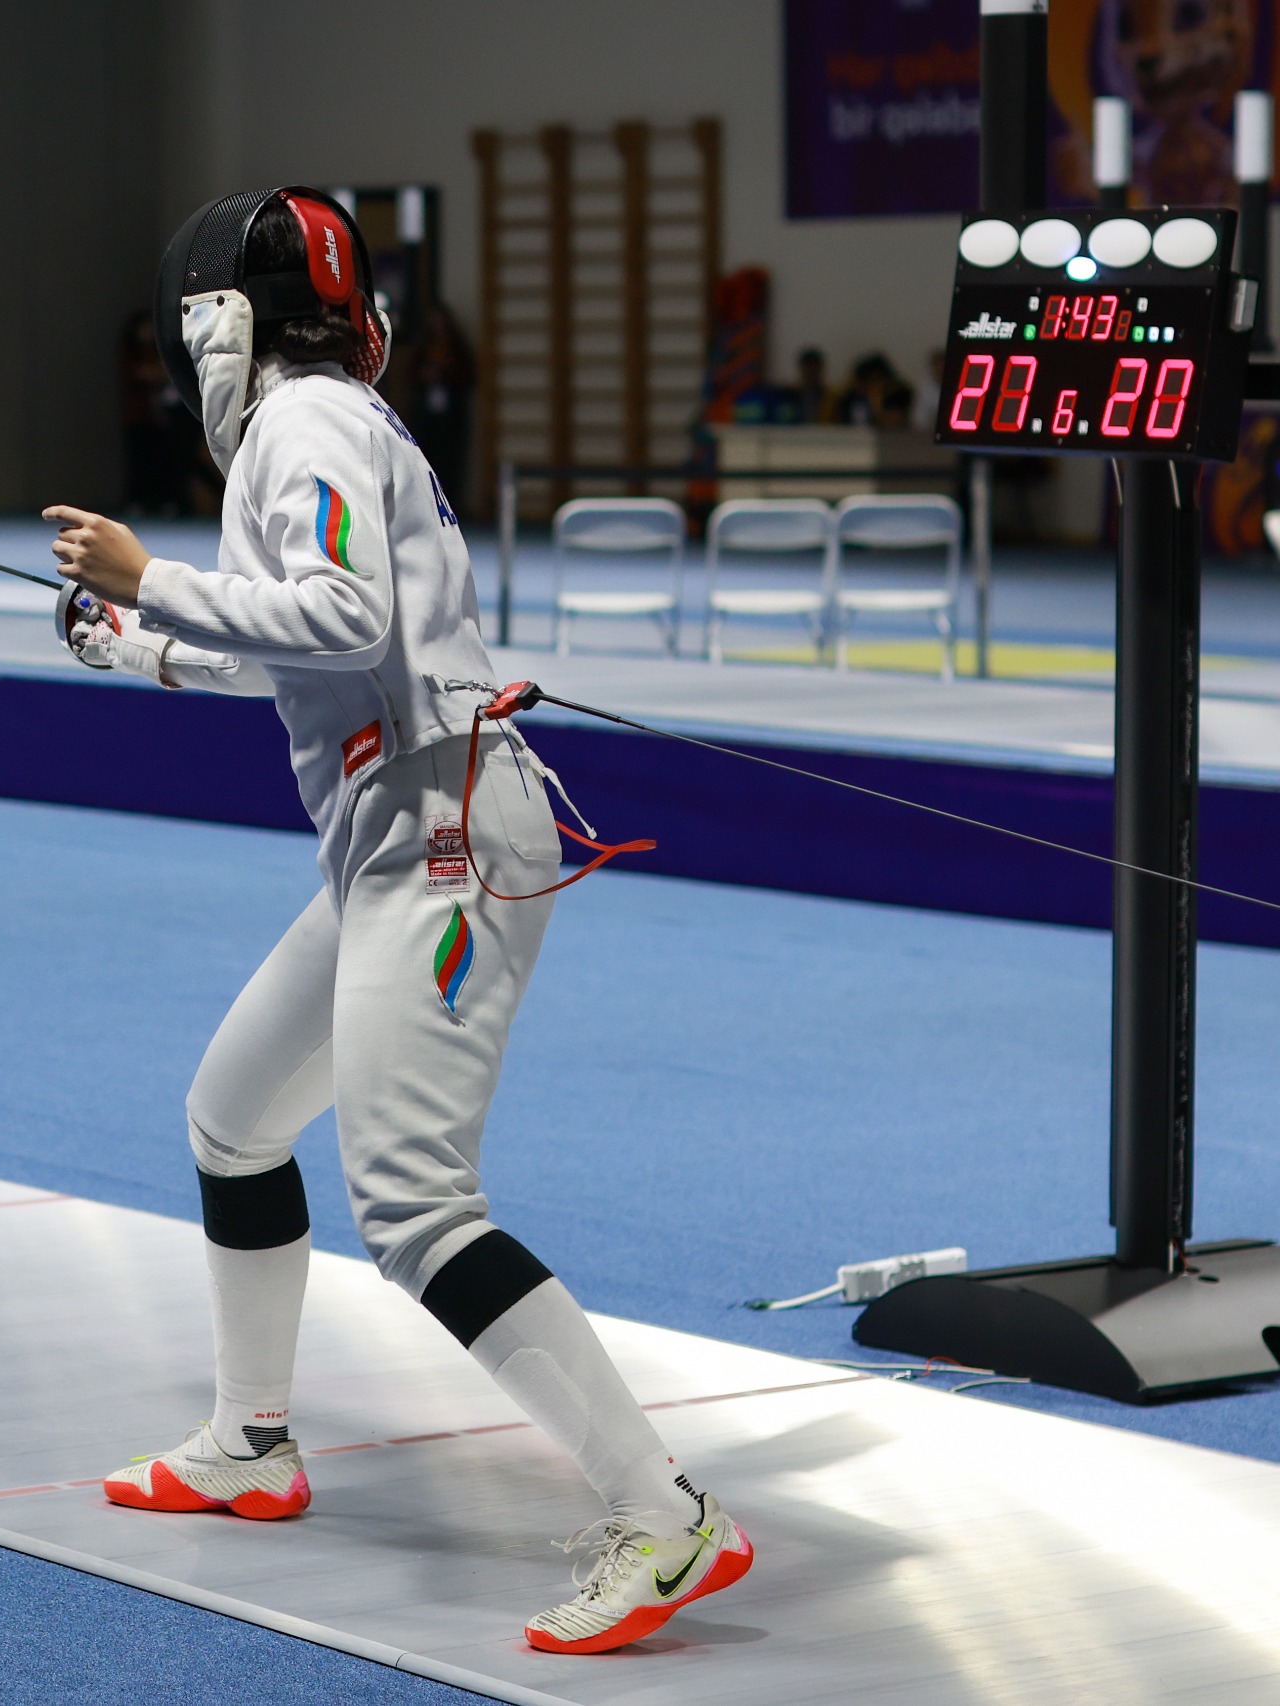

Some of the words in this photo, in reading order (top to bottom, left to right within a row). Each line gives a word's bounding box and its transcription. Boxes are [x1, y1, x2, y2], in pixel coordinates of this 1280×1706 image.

[323, 226, 341, 284] allstar
[957, 312, 1018, 339] allstar
[949, 354, 1039, 432] 27
[1052, 389, 1078, 434] 6
[1101, 357, 1195, 439] 20
[346, 735, 378, 764] allstar
[437, 829, 461, 838] allstar
[430, 859, 465, 868] allstar
